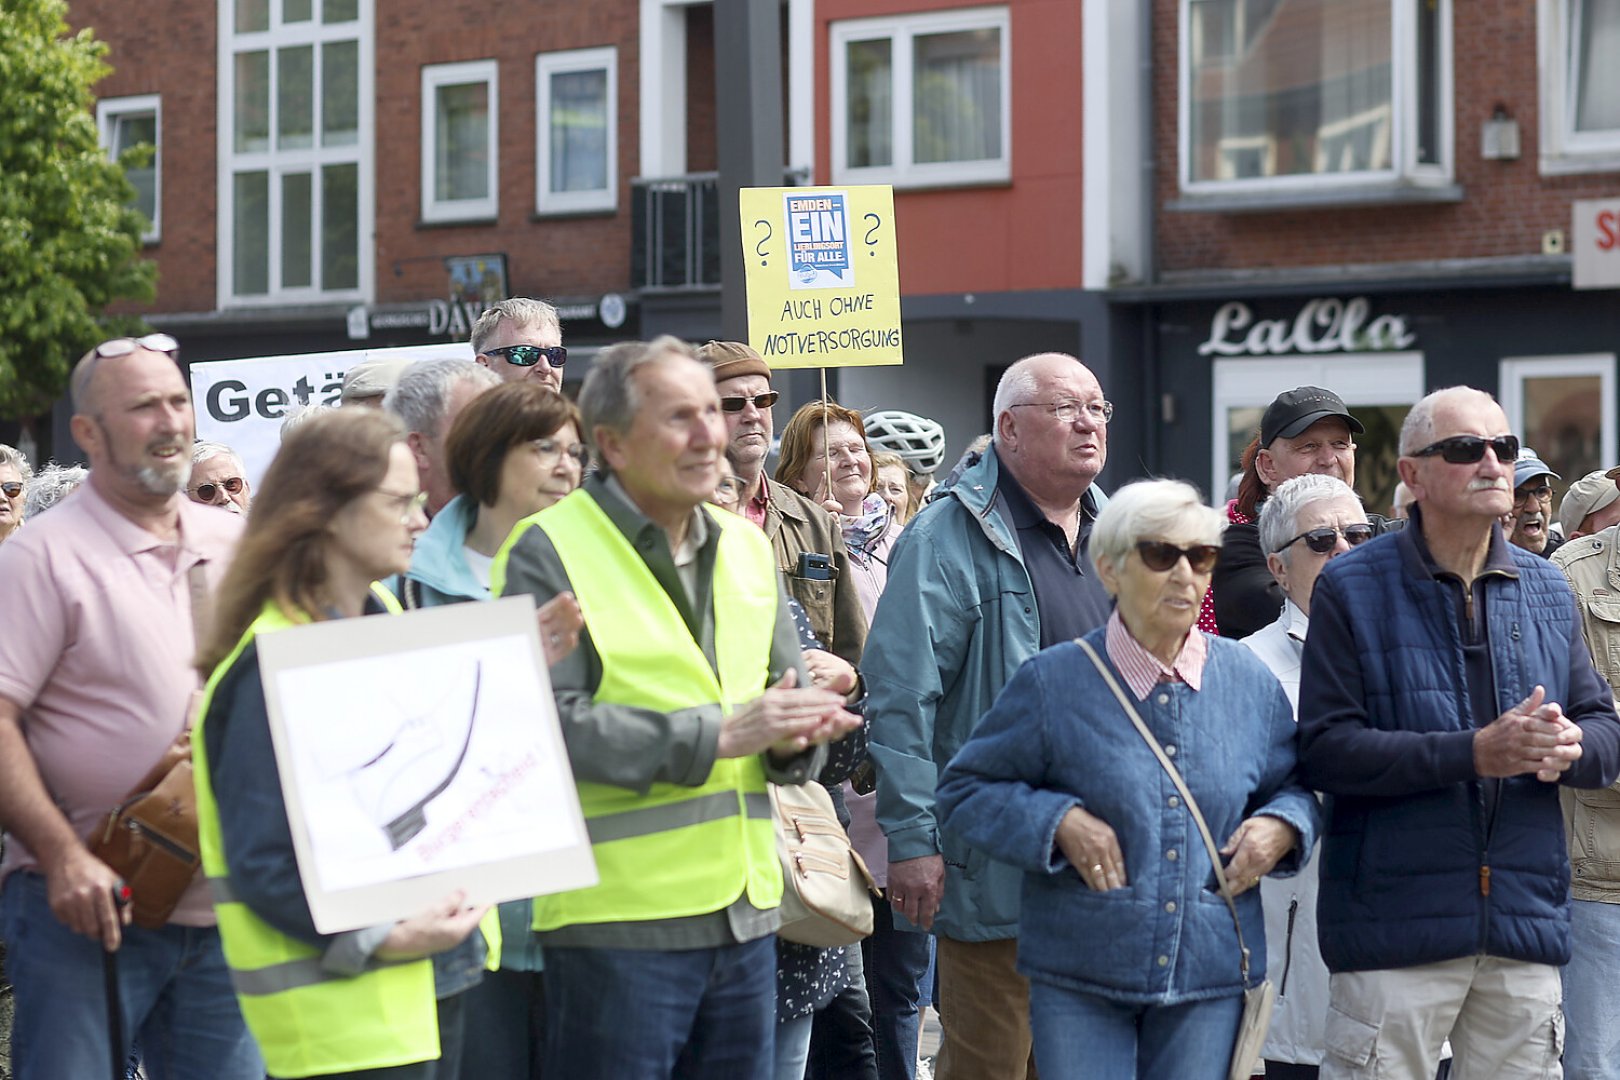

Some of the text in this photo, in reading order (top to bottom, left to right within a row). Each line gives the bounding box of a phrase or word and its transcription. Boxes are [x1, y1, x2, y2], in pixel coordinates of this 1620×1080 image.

[791, 211, 844, 242] EIN
[1595, 210, 1620, 252] S
[794, 250, 815, 263] FÜR
[780, 294, 875, 322] AUCH OHNE
[763, 327, 900, 356] NOTVERSORGUNG
[1197, 297, 1417, 356] LaOla
